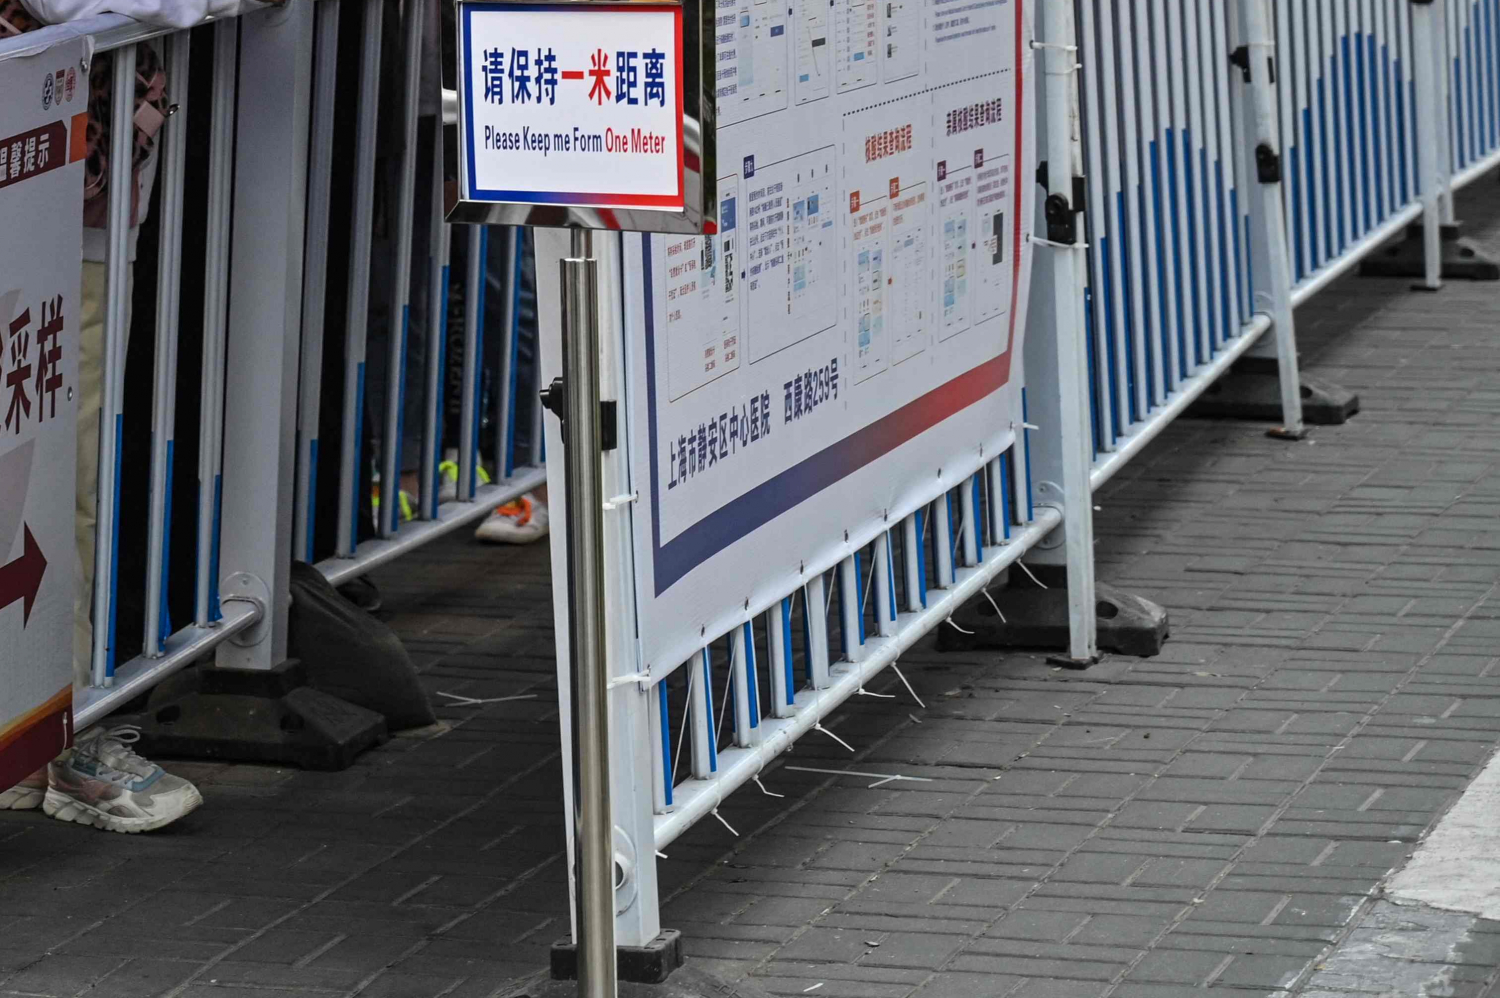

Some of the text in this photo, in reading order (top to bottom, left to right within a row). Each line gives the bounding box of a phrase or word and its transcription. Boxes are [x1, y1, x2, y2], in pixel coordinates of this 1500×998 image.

[482, 47, 665, 108] 请保持一米距离
[484, 125, 665, 157] Please Keep me Form One Meter
[864, 123, 912, 164] 核酸结果查询流程
[667, 357, 839, 490] 上海市静安区中心医院 西康路259号
